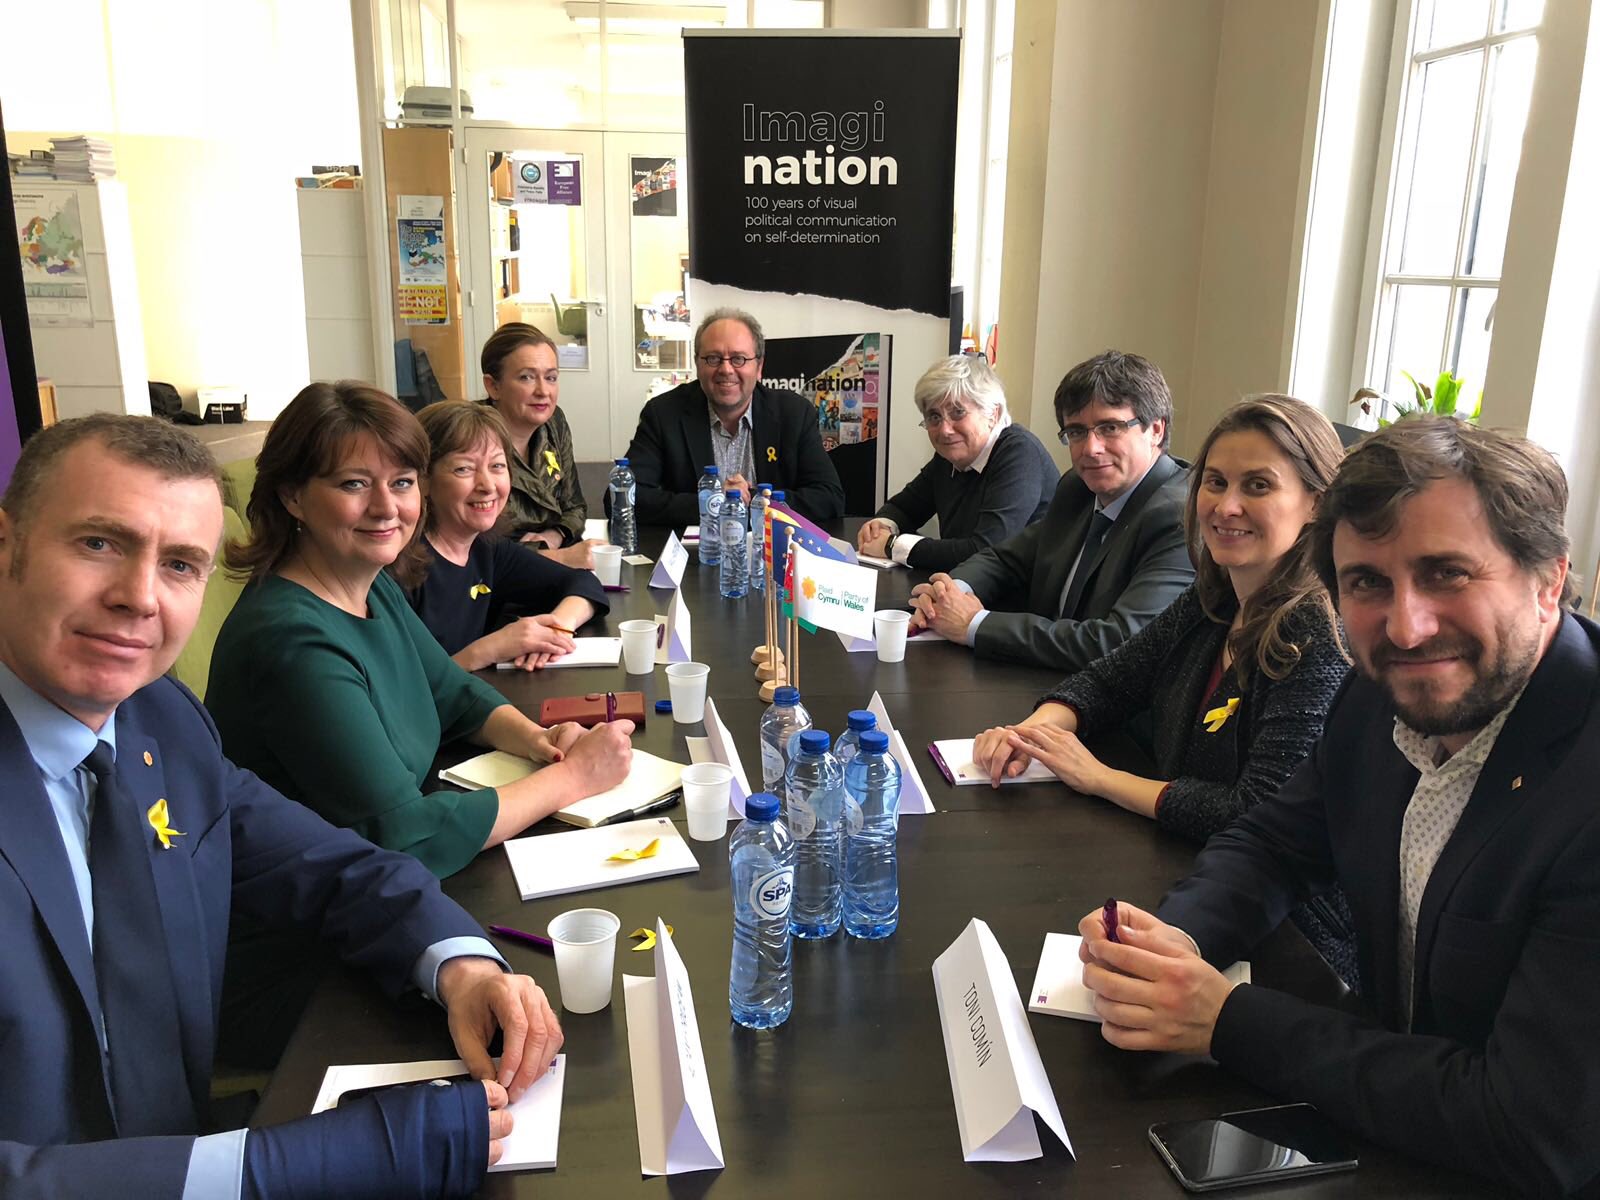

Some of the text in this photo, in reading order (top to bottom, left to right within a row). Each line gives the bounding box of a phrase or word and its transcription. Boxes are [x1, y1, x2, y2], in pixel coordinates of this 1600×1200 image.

[743, 100, 885, 151] Imagi
[743, 144, 898, 185] nation
[745, 196, 857, 212] 100 years of visual
[745, 213, 897, 229] political communication
[744, 230, 881, 243] on self-determination
[415, 296, 441, 307] NOT
[637, 352, 658, 364] Yes
[762, 373, 866, 393] magination
[818, 592, 840, 605] Cymru
[844, 590, 861, 603] Party
[844, 599, 865, 611] Wales
[762, 883, 791, 902] SPA
[963, 981, 993, 1068] TONI COMÍN
